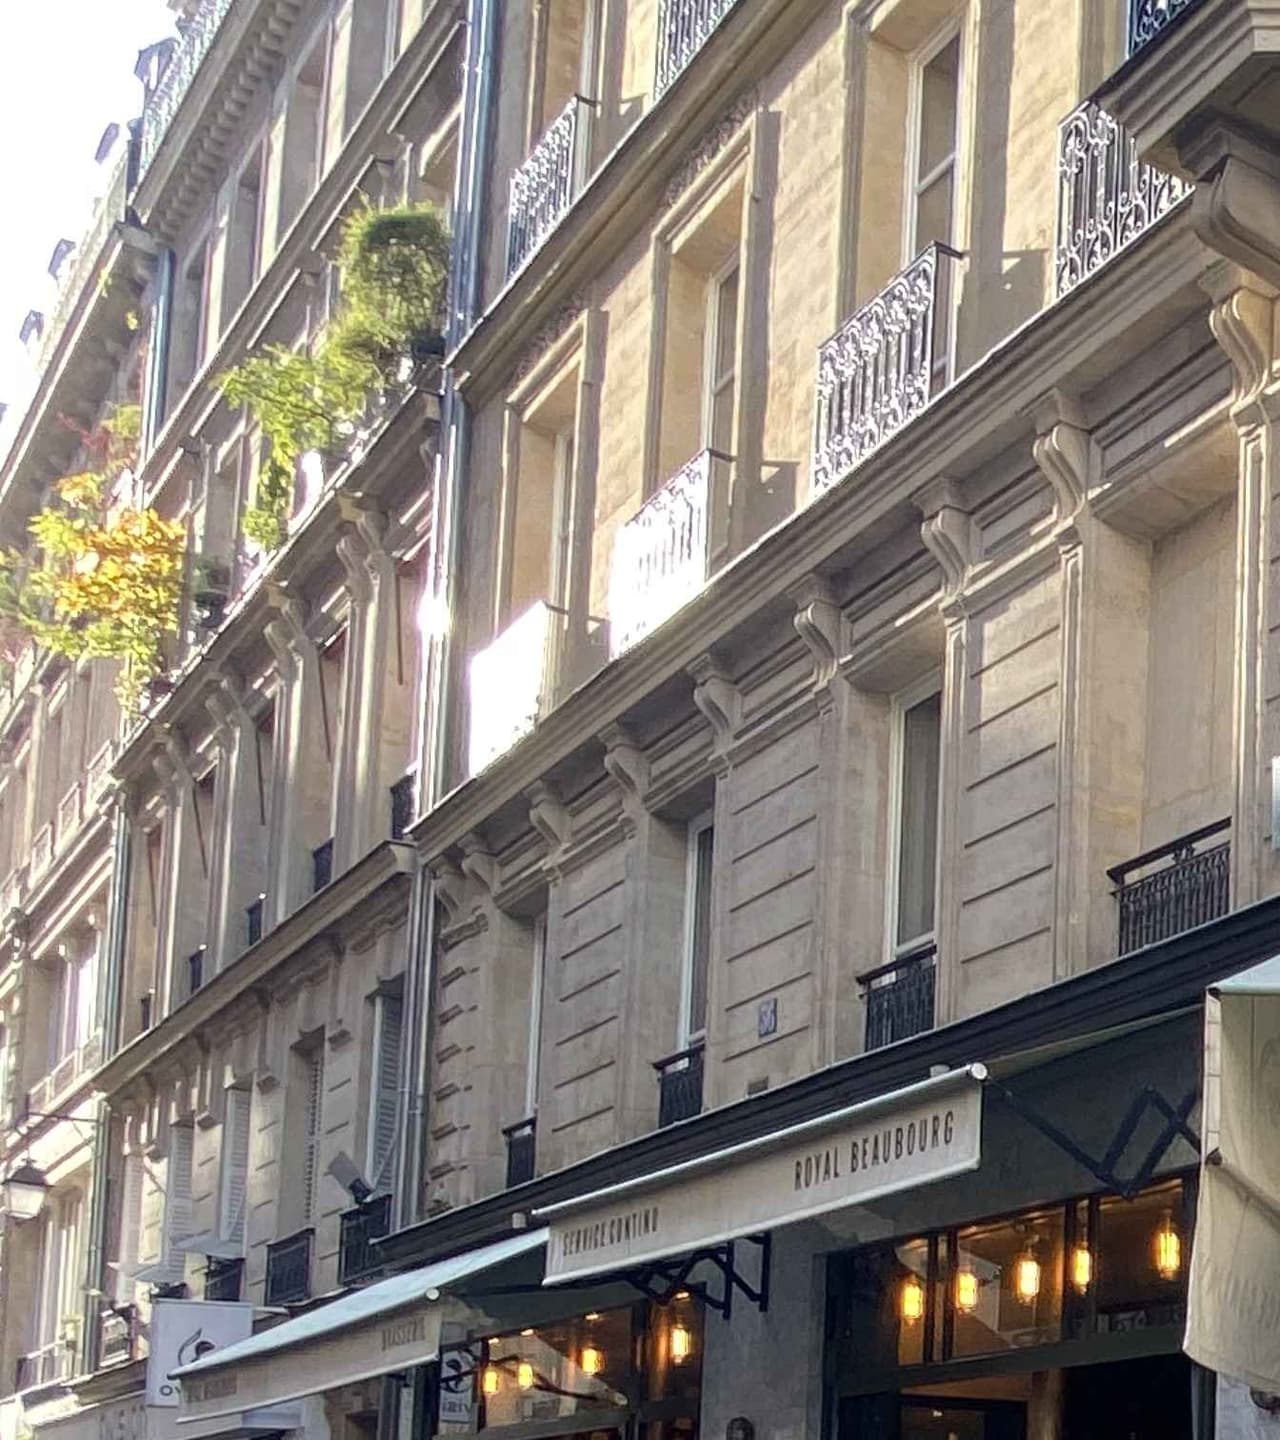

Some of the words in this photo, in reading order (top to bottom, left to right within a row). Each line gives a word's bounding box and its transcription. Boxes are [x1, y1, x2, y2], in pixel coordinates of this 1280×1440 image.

[794, 1147, 840, 1191] ROYAL
[850, 1110, 954, 1173] BEAUBOURG
[563, 1223, 606, 1257] SERVICE
[609, 1206, 659, 1245] CONTINU
